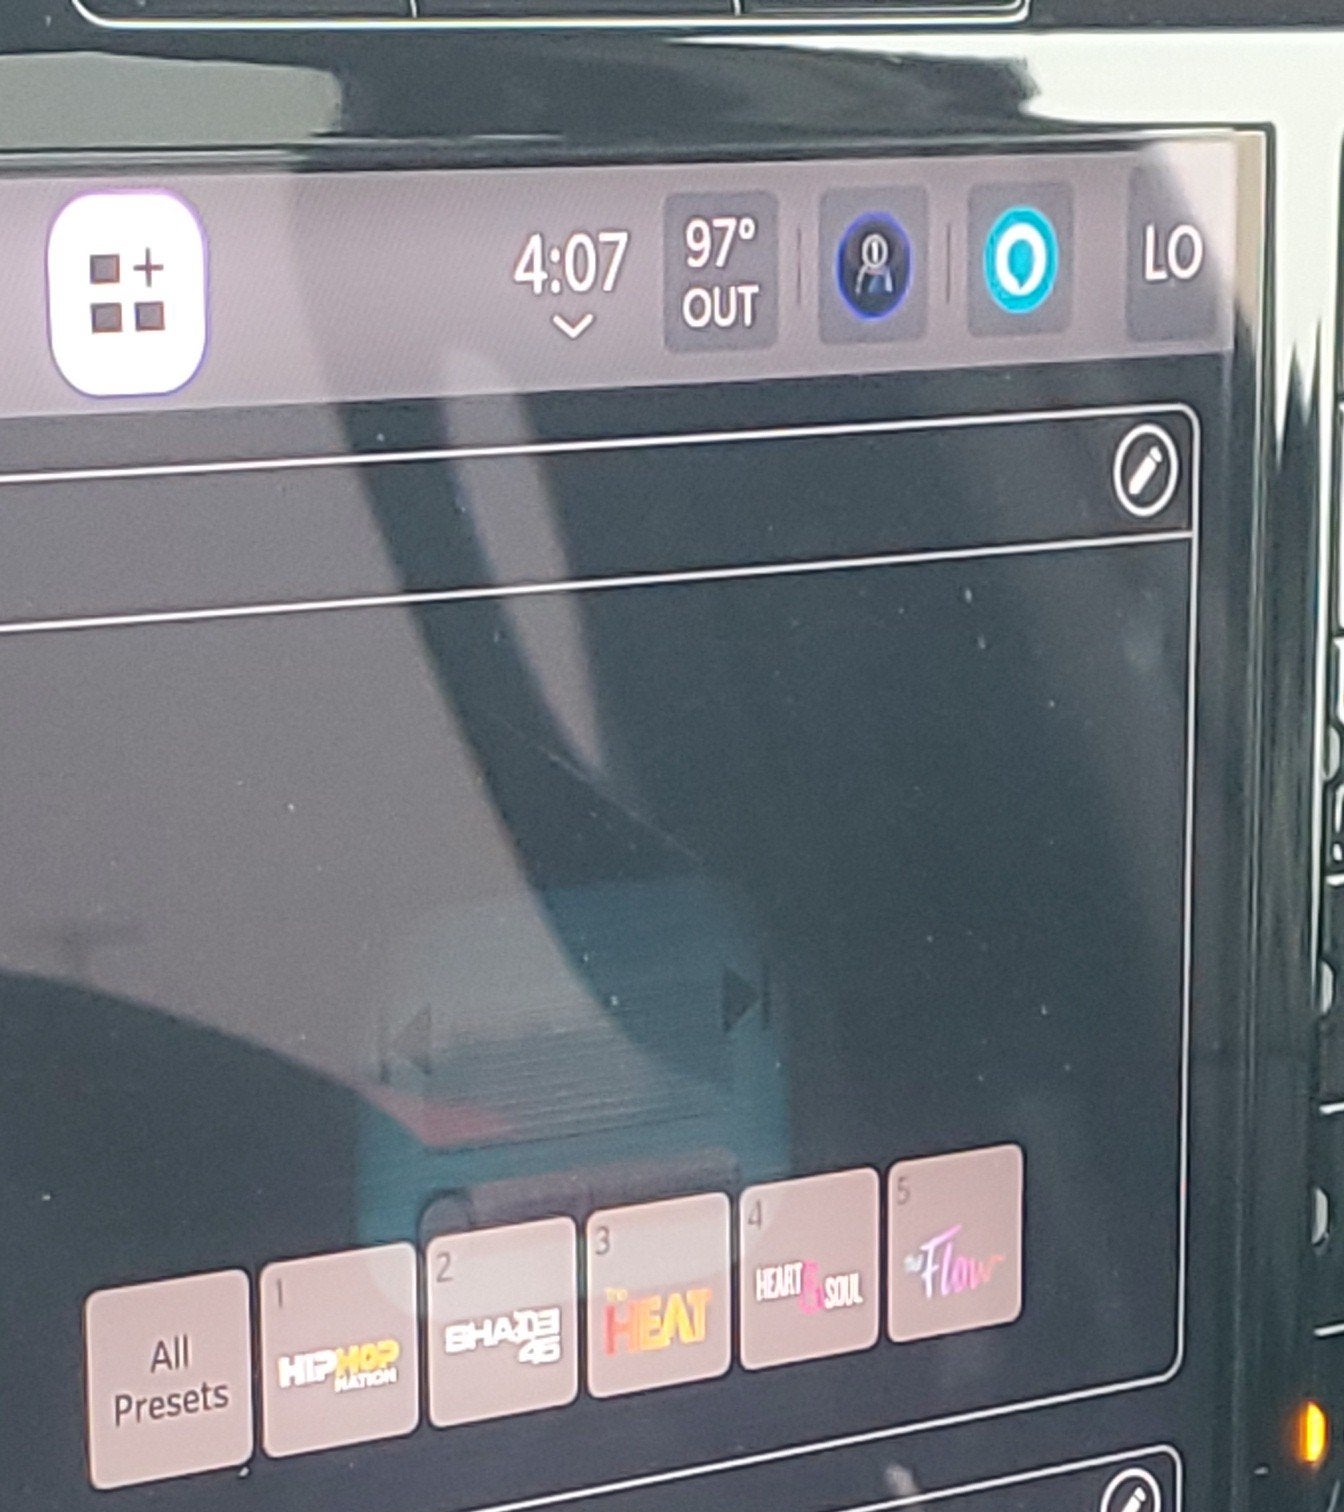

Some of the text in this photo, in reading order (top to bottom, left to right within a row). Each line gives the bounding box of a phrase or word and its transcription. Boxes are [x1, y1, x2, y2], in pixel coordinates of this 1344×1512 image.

[512, 231, 629, 295] 4:07
[684, 216, 756, 270] 97°
[1144, 223, 1204, 282] LO
[682, 284, 759, 329] OUT
[896, 1175, 911, 1206] 5
[747, 1199, 763, 1230] 4
[594, 1225, 611, 1256] 3
[435, 1251, 454, 1284] 2
[755, 1261, 804, 1301] HEART
[824, 1272, 863, 1310] SOUL
[603, 1287, 713, 1357] HEAT
[150, 1335, 191, 1374] All
[114, 1381, 230, 1427] Presets
